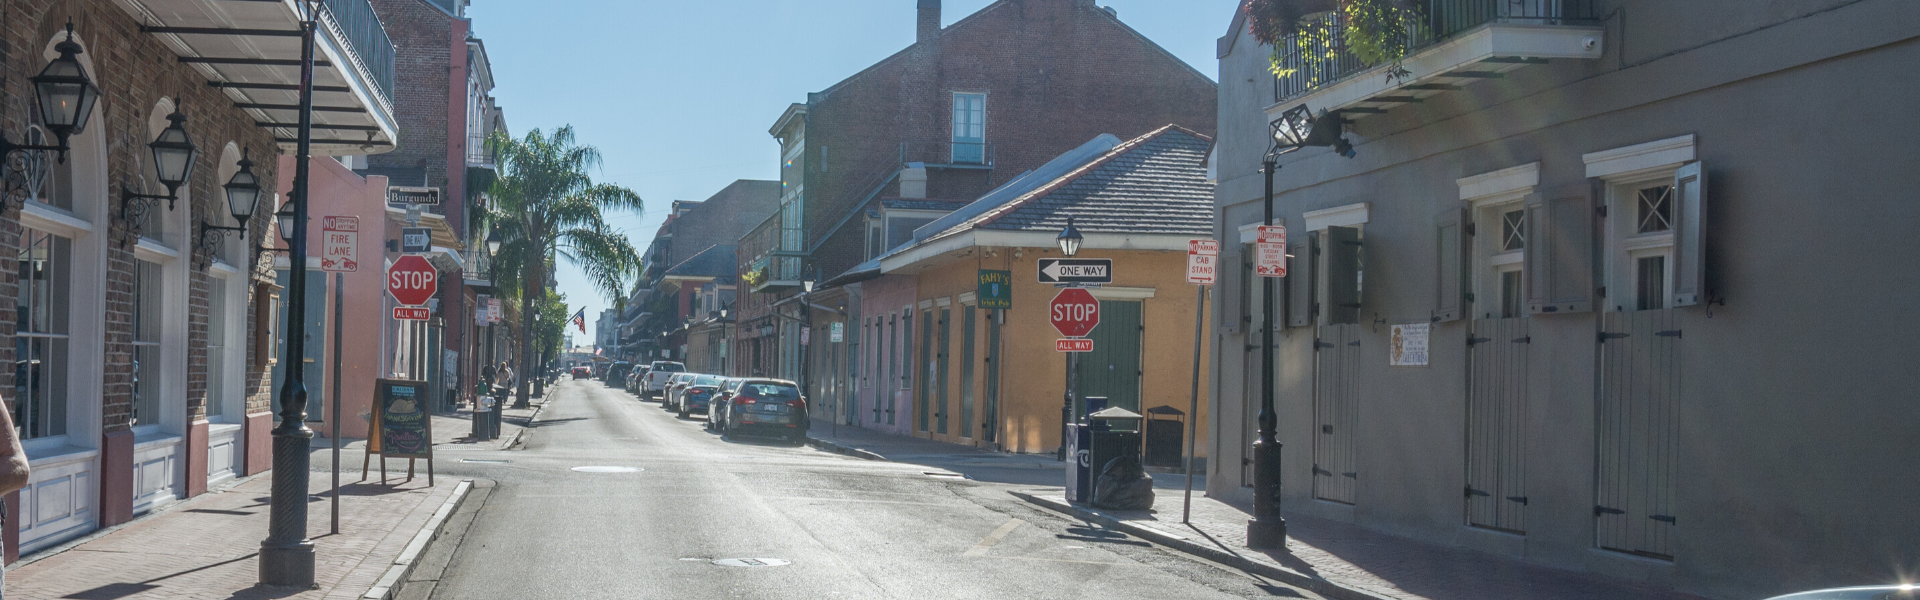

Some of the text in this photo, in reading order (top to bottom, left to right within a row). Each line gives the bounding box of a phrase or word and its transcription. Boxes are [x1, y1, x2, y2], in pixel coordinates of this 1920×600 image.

[391, 192, 437, 204] Burgundy
[323, 218, 336, 229] NO
[330, 234, 350, 244] FIRE
[1257, 229, 1266, 240] NO
[405, 236, 423, 246] ONE WAY
[329, 246, 351, 256] LANE
[1190, 243, 1198, 252] NO
[1196, 256, 1209, 264] CAB
[1060, 266, 1104, 276] ONE WAY
[1192, 266, 1212, 274] STAND
[391, 270, 434, 290] STOP
[980, 272, 1010, 286] FAHY'S
[396, 310, 427, 318] ALL WAY
[1053, 304, 1096, 322] STOP
[1058, 342, 1090, 350] ALL WAY
